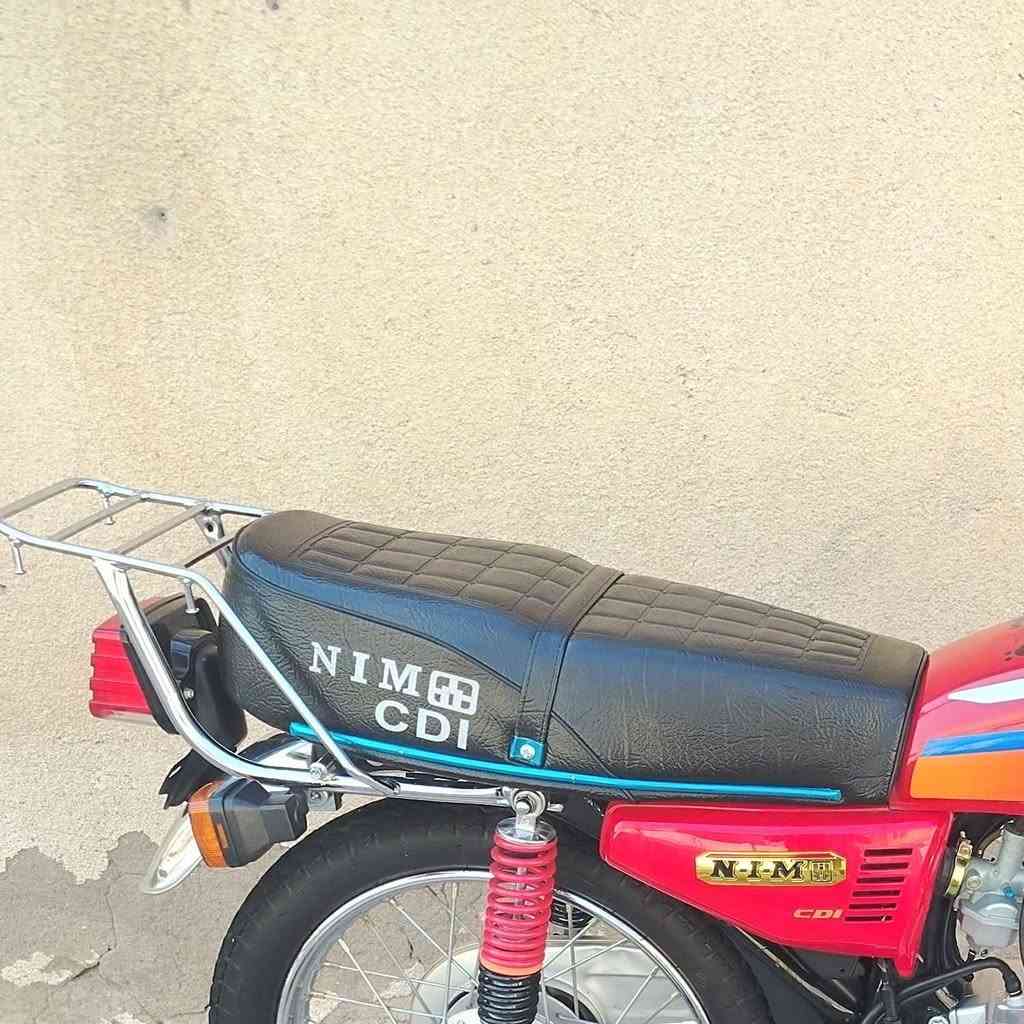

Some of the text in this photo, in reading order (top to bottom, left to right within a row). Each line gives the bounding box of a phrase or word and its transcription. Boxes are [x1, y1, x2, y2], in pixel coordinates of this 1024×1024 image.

[309, 641, 422, 697] NIM
[375, 700, 469, 750] CDI
[793, 908, 843, 919] CDI
